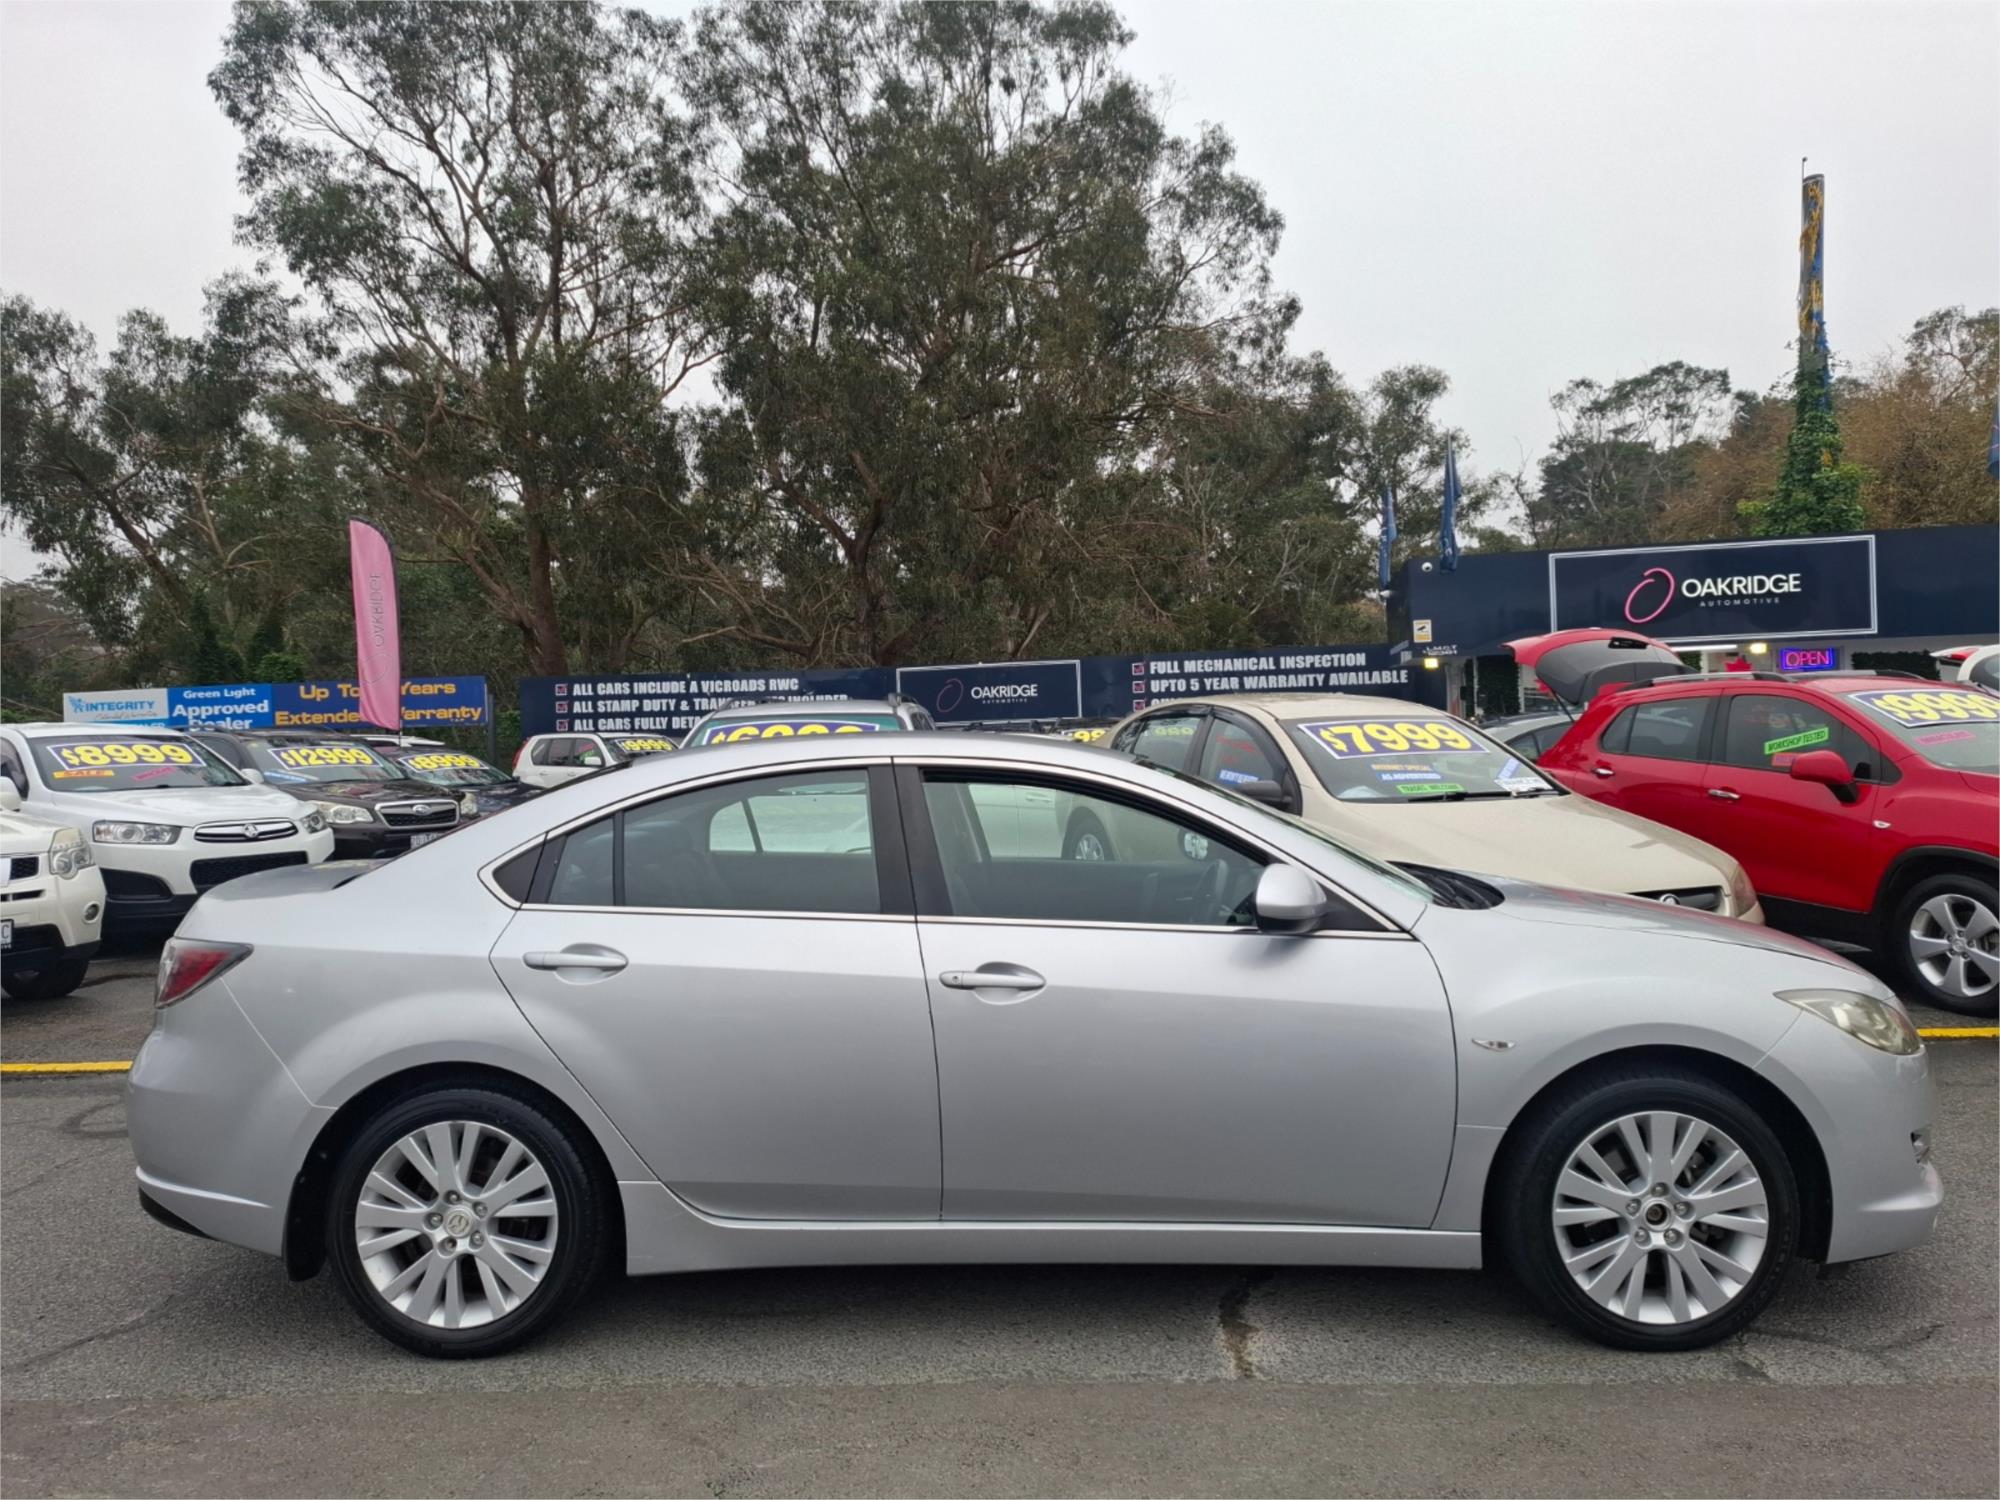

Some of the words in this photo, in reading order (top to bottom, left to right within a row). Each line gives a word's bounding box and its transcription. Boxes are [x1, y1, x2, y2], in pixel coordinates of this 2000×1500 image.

[1681, 573, 1801, 597] OAKRIDGE
[1700, 597, 1780, 607] AUTOMOTIVE
[1150, 661, 1180, 674] FULL
[1184, 657, 1276, 673] MECHANICAL
[1280, 653, 1366, 669] INSPECTION
[1785, 651, 1829, 668] OPEN
[573, 683, 594, 696] ALL
[597, 682, 630, 695] CARS
[633, 681, 686, 694] INCLUDE
[689, 681, 698, 693] A
[701, 679, 766, 693] VICROADS
[769, 678, 799, 691] RWC
[1150, 679, 1186, 693] UPTO
[1190, 679, 1200, 691] 5
[1204, 677, 1239, 691] YEAR
[1243, 673, 1325, 690] WARRANTY
[1329, 669, 1409, 686] AVAILABLE
[183, 690, 221, 699] Green
[223, 687, 256, 699] Light
[300, 685, 329, 701] Up
[971, 684, 1038, 699] OAKRIDGE
[86, 700, 155, 712] INTEGRITY
[172, 700, 269, 719] Approved
[573, 700, 594, 713] ALL
[597, 699, 639, 713] STAMP
[643, 699, 676, 711] DUTY
[680, 700, 689, 711] &
[188, 717, 253, 731] Dealer
[275, 709, 362, 726] Extende
[401, 705, 482, 721] arranty
[573, 718, 594, 731] ALL
[598, 717, 630, 730] CARS
[634, 717, 668, 730] FULLY
[1320, 723, 1472, 752] $7999
[61, 744, 193, 765] $8999
[280, 748, 373, 766] $12999
[408, 754, 480, 769] $8999
